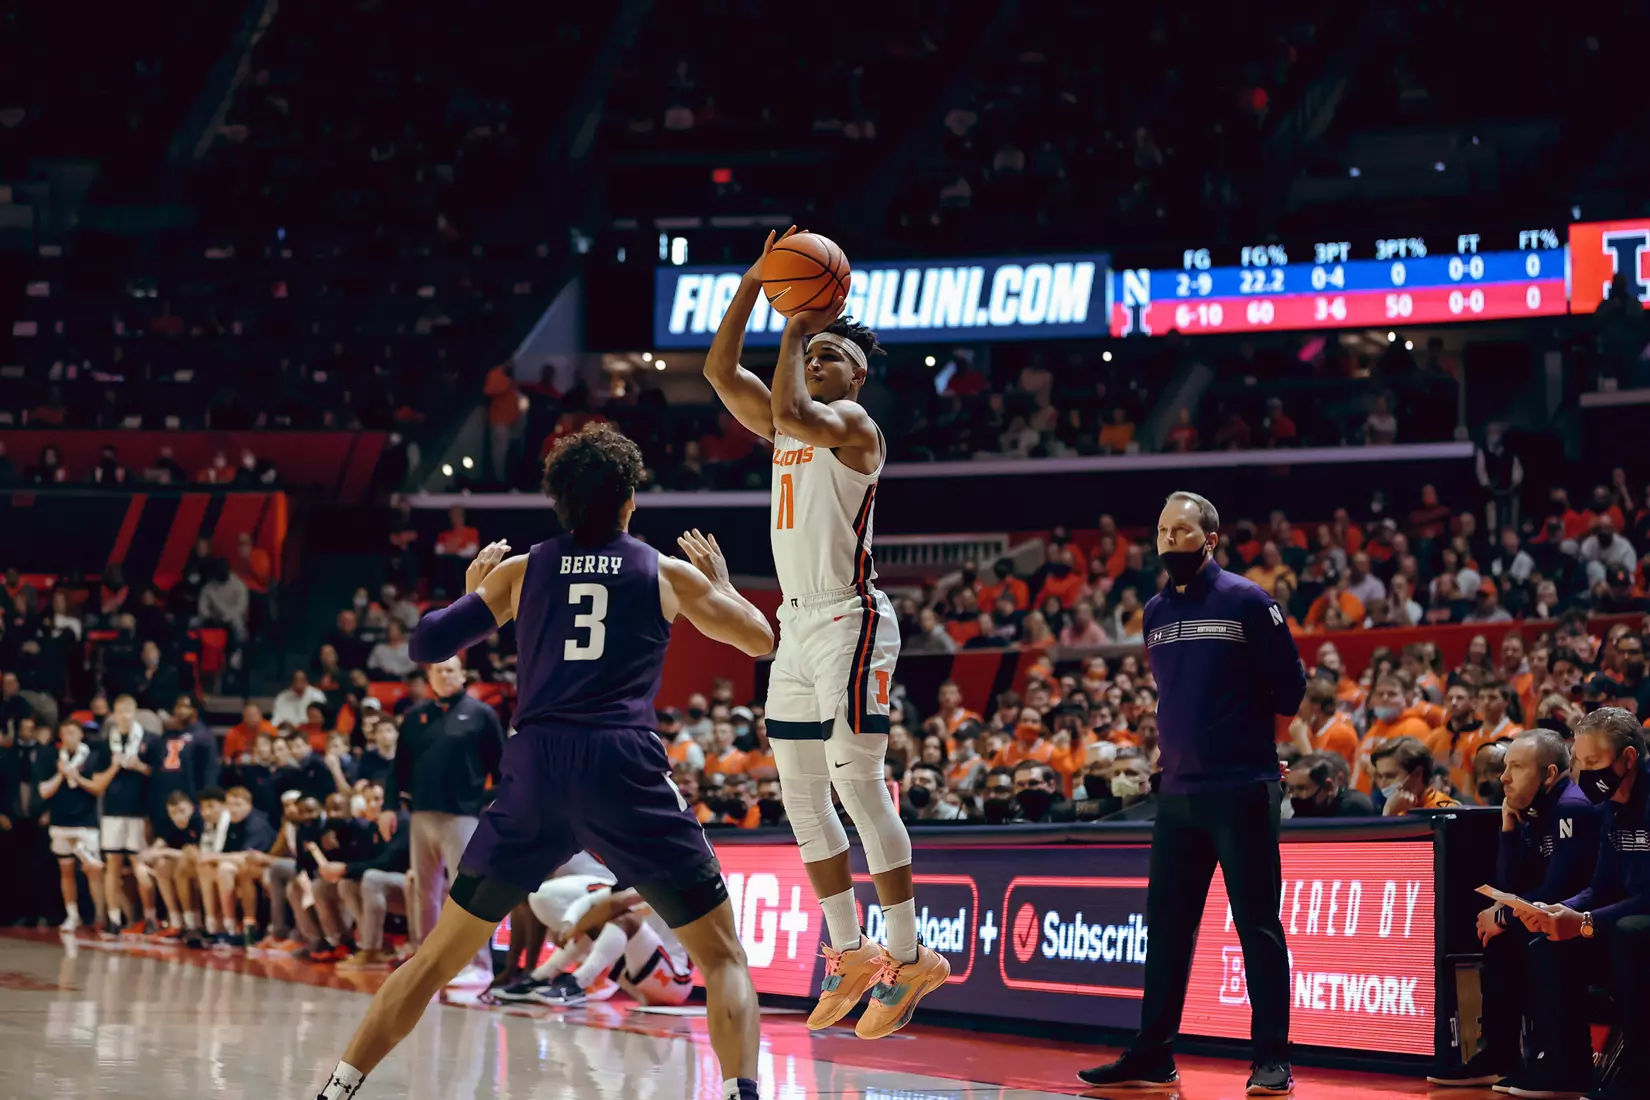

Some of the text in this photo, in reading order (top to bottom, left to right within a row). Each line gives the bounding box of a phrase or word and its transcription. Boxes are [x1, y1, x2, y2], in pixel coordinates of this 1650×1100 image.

[1184, 228, 1558, 269] FG FG% 3PT 3PT% FT FT%
[1123, 253, 1540, 306] N 2-9 22.2 0-4 0 0-0 0
[1175, 302, 1223, 328] 6-10
[1247, 300, 1275, 324] 60
[1314, 296, 1347, 320] 3-6
[1385, 293, 1413, 318] 50
[1448, 289, 1484, 314] 0-0
[1526, 285, 1541, 309] 0
[560, 555, 622, 575] BERRY
[564, 583, 608, 661] 3
[1268, 604, 1284, 626] N
[1559, 818, 1573, 839] N
[1379, 880, 1420, 938] BY
[1042, 910, 1148, 964] Subscrib
[1294, 971, 1418, 1016] NETWORK
